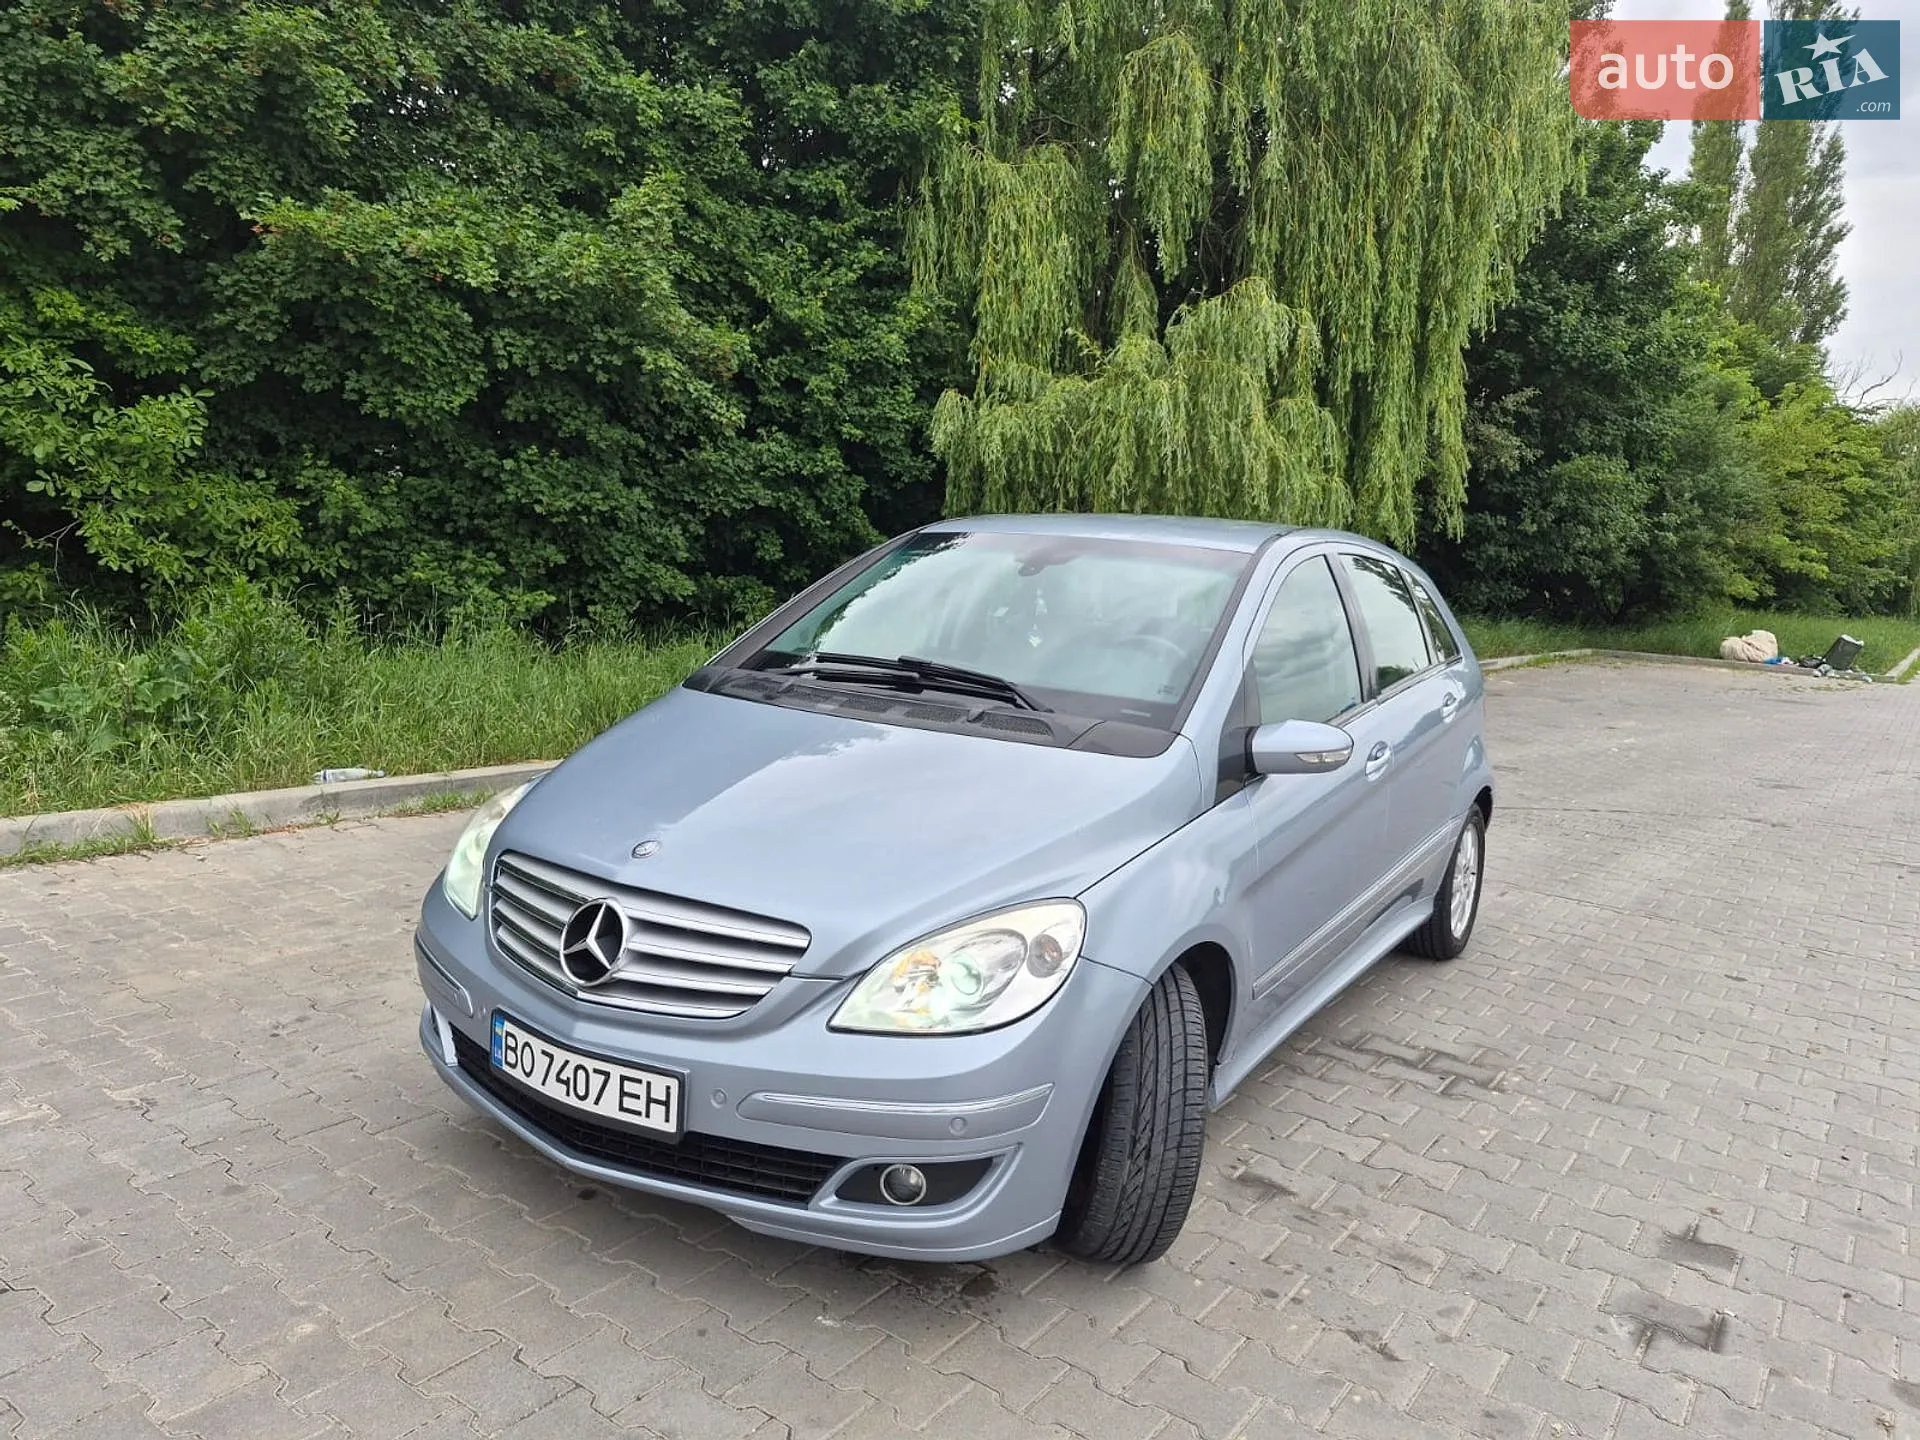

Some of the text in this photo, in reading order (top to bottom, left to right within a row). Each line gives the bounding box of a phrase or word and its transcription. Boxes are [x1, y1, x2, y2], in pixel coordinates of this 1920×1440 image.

[504, 1030, 671, 1123] BO 7407 EH
